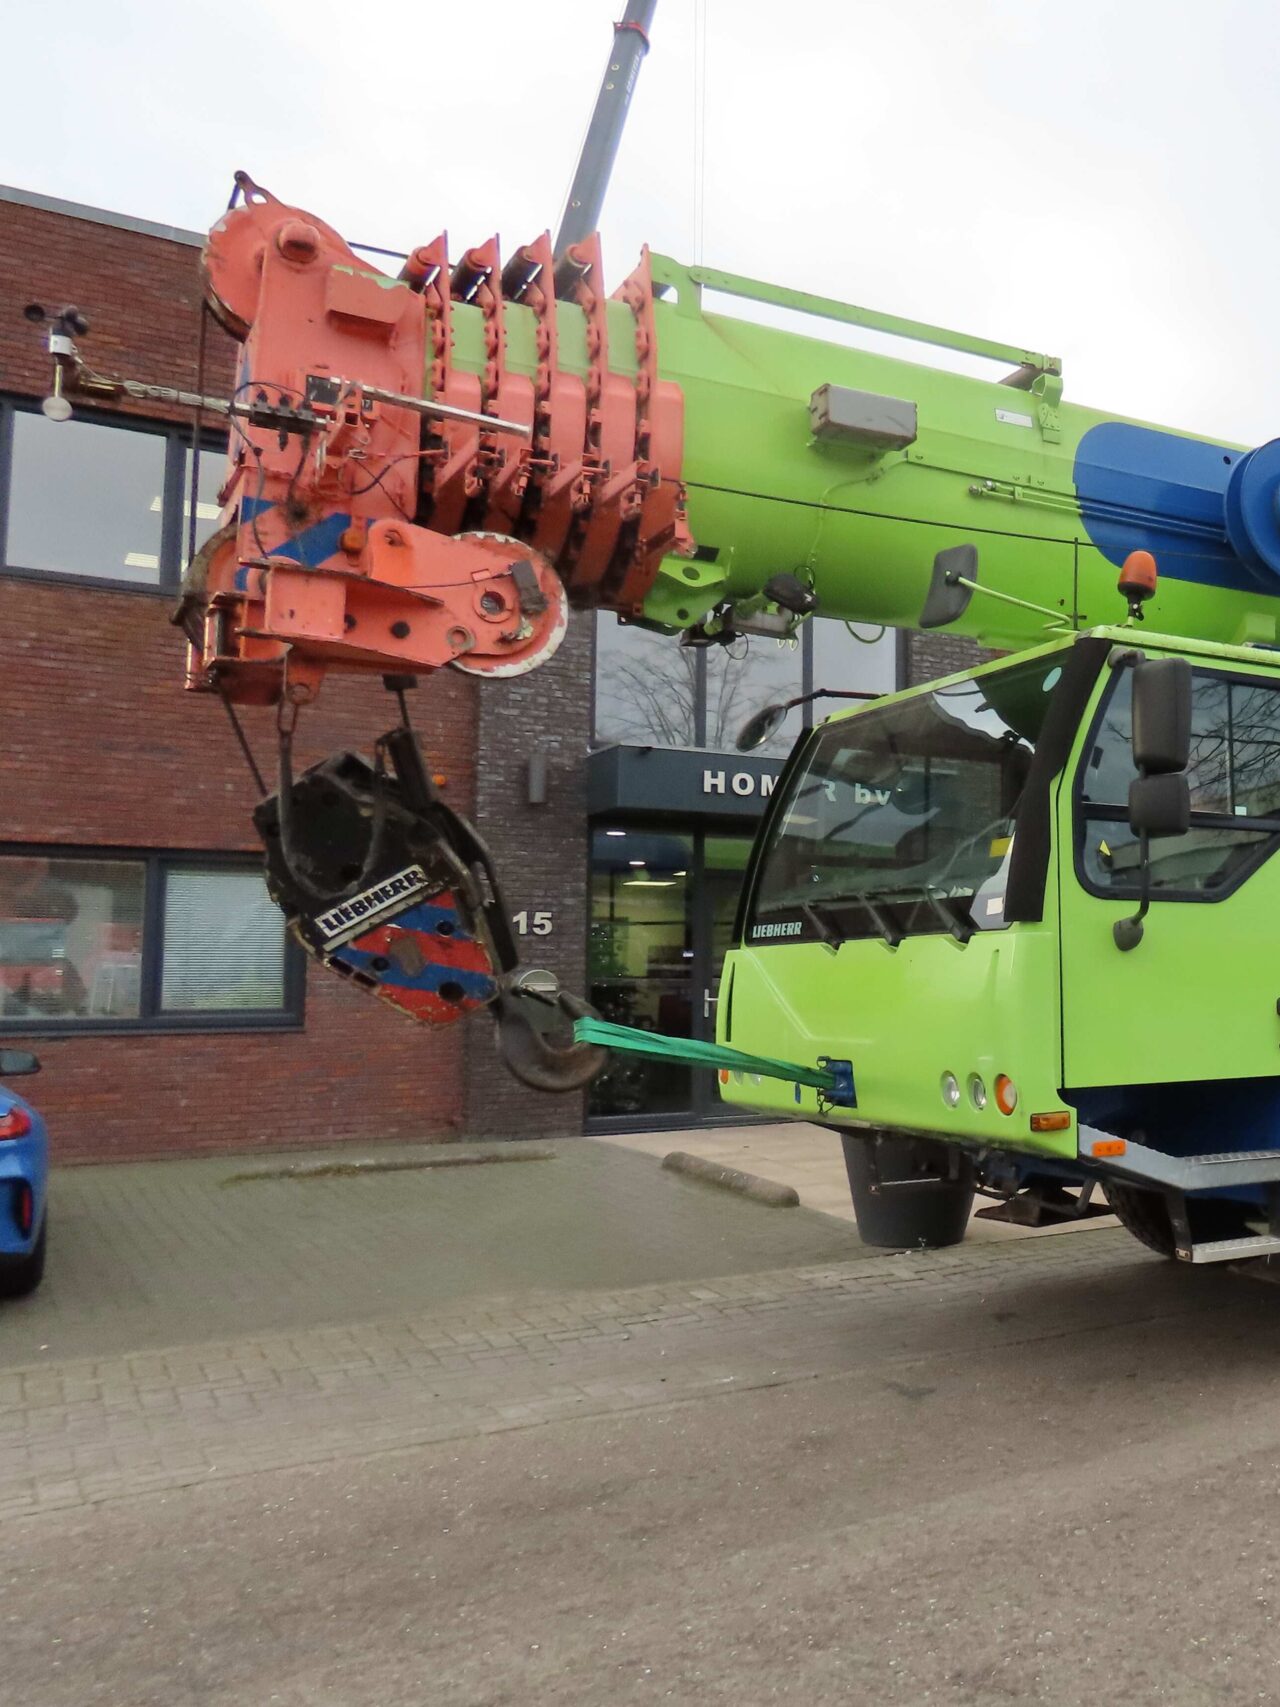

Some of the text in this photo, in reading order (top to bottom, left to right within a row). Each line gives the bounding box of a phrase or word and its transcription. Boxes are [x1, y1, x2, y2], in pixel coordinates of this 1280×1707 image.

[320, 869, 424, 933] LIEBHERR
[512, 910, 553, 935] 15
[752, 921, 803, 939] LIEBHERR
